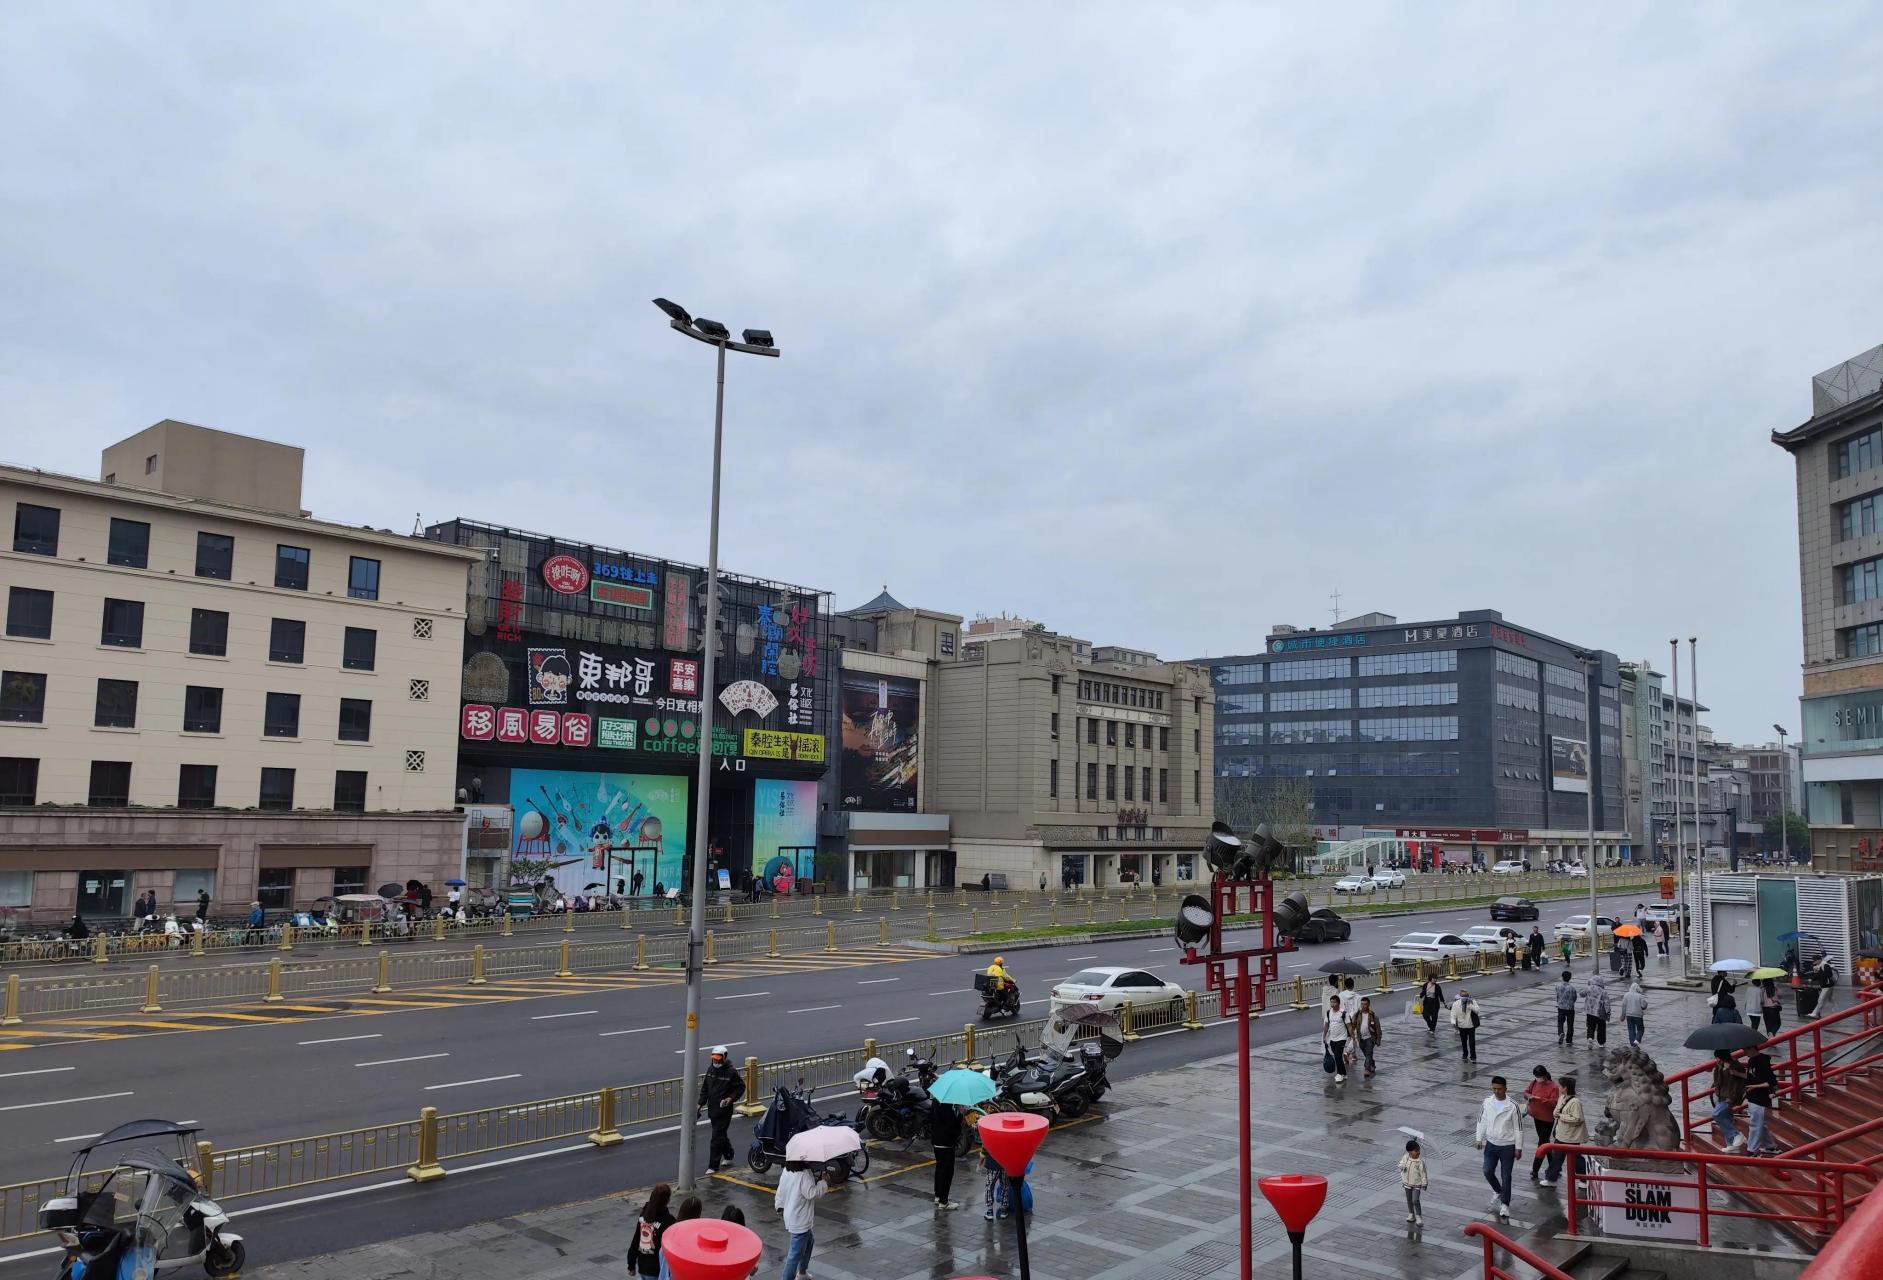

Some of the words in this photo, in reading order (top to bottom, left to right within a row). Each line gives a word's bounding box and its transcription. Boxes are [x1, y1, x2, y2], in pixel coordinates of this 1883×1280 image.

[673, 661, 696, 676] 平安
[1834, 704, 1883, 727] SEMI
[467, 710, 588, 741] 移風易俗
[750, 732, 790, 749] 秦腔生来
[799, 737, 820, 753] 摇滚
[1625, 1188, 1672, 1207] SLAM
[1626, 1208, 1672, 1223] DUNK
